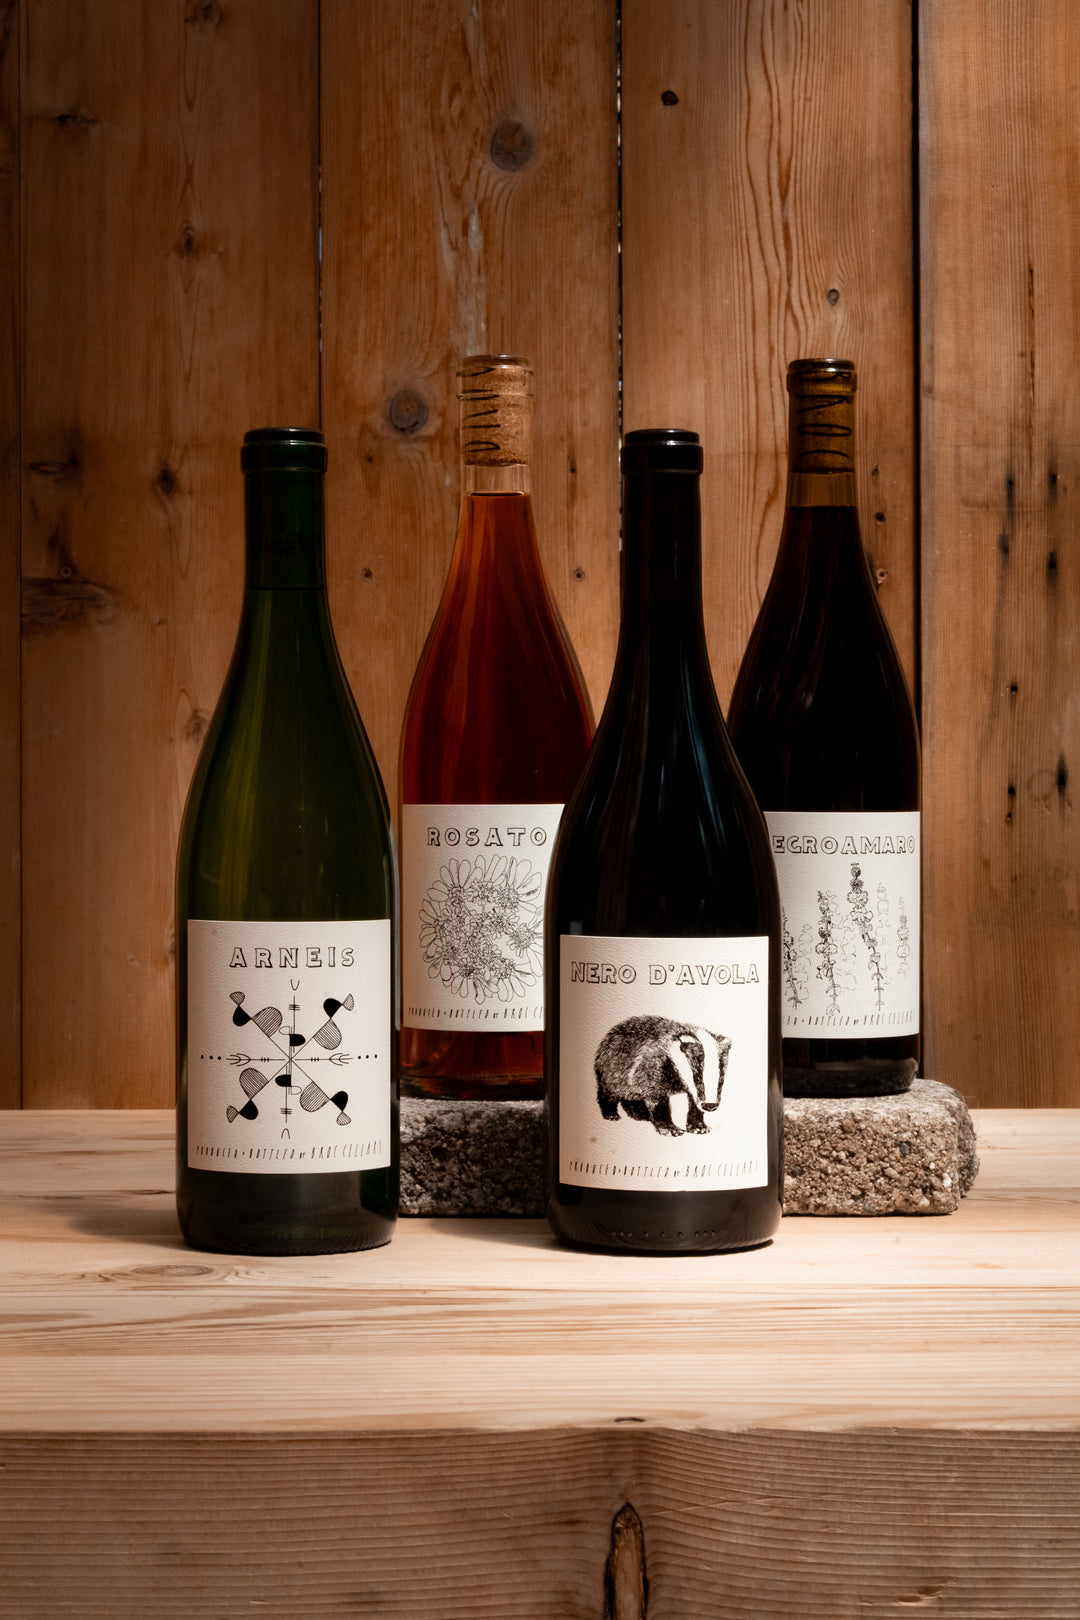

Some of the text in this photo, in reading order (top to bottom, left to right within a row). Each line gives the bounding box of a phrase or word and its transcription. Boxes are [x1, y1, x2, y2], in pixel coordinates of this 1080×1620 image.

[427, 827, 547, 847] ROSATO
[772, 835, 915, 854] EGROAMARO
[229, 946, 355, 968] ARNEIS
[570, 961, 760, 985] NERO D'AVOLA
